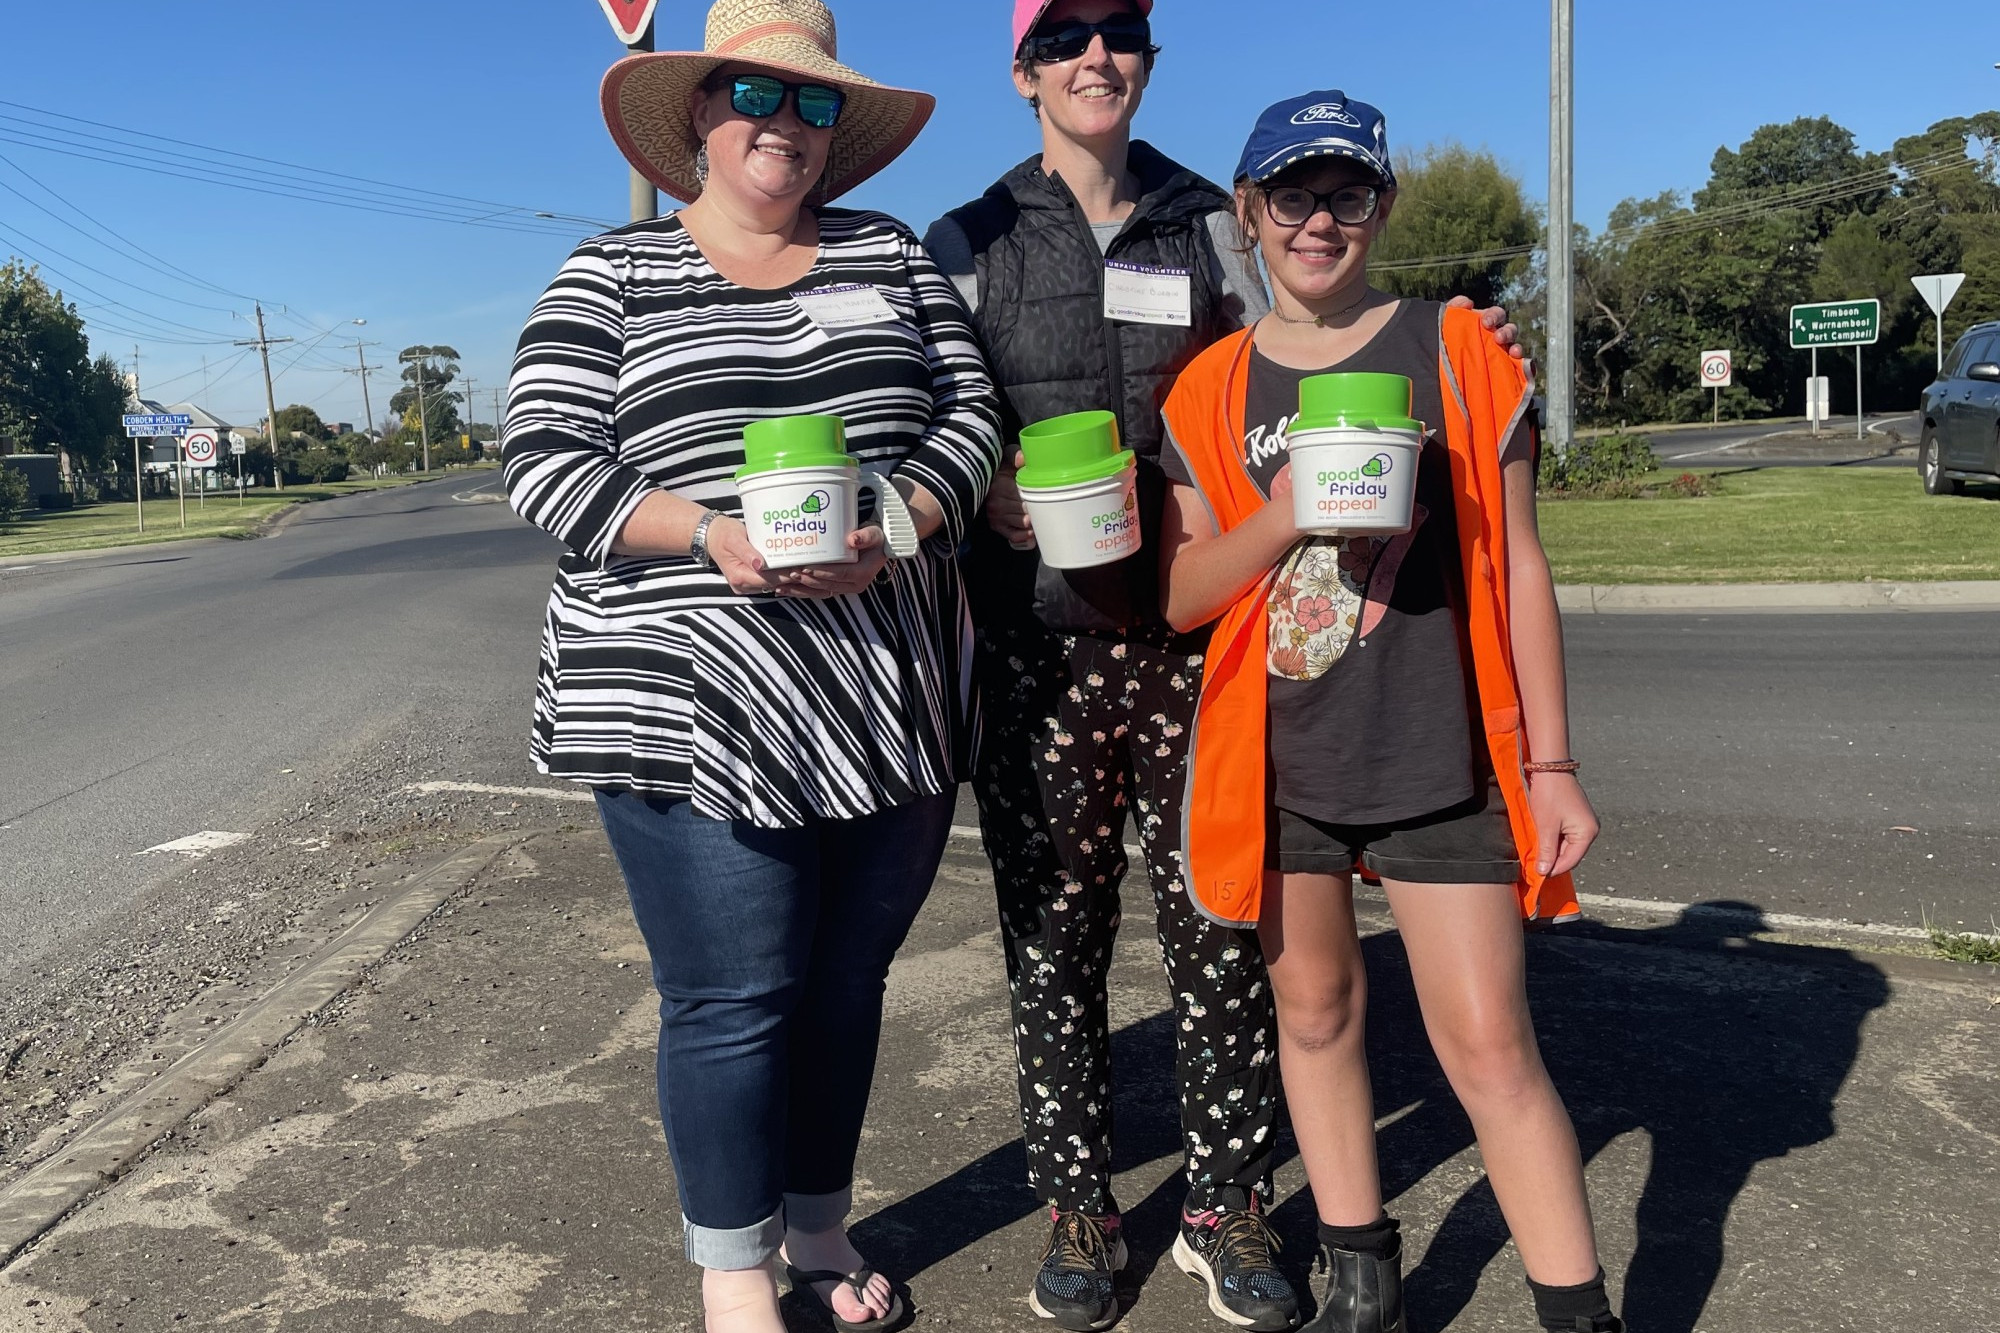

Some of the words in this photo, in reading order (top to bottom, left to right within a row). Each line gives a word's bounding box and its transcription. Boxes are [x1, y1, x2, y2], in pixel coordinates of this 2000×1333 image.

[1303, 106, 1350, 123] Ford
[1108, 261, 1137, 271] UNPAID
[1140, 266, 1186, 275] VOLUNTEER
[794, 289, 823, 297] UNPAID
[826, 282, 871, 293] VOLUNTEER
[1821, 307, 1859, 318] Timboon
[1811, 318, 1870, 331] Warrnambool
[1808, 332, 1828, 342] Port
[1831, 329, 1873, 341] Campbell
[1706, 362, 1725, 375] 60
[126, 416, 154, 425] COBDEN
[155, 415, 183, 424] HEALTH
[191, 441, 210, 454] 50
[1317, 467, 1360, 486] good
[1330, 481, 1387, 499] friday
[1317, 496, 1377, 514] appeal
[763, 505, 800, 525] good
[1091, 505, 1125, 528] good
[775, 518, 827, 534] friday
[766, 532, 818, 551] appeal
[1214, 880, 1236, 901] 15
